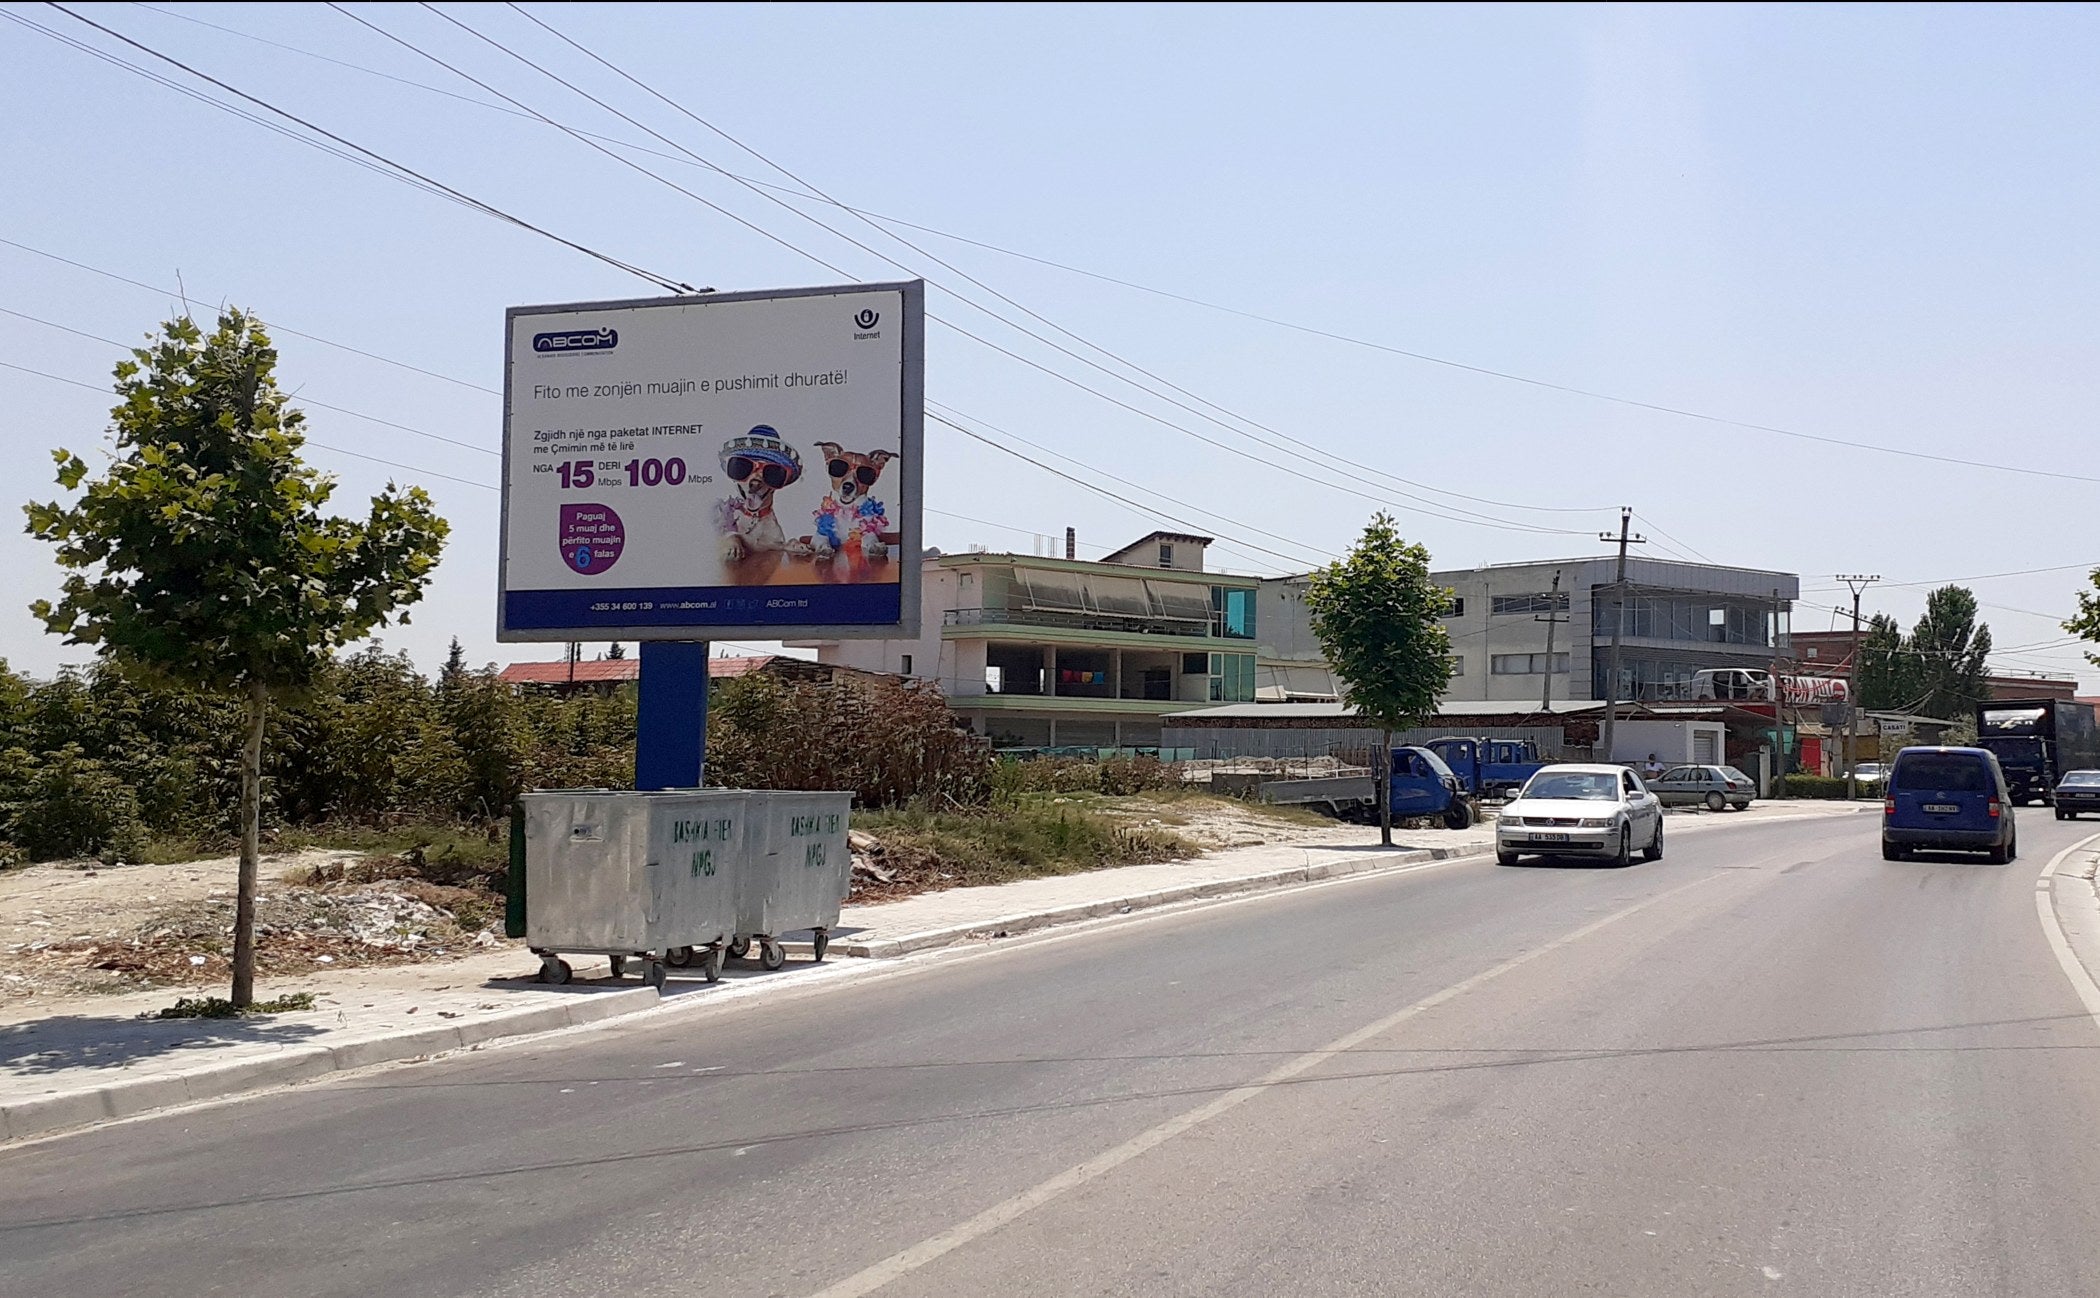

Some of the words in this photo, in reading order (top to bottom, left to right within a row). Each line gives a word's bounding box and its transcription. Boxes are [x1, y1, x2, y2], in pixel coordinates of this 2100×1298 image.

[537, 330, 613, 349] ABCOM
[854, 331, 880, 340] Internet
[534, 385, 561, 399] Fito
[566, 386, 589, 397] me
[594, 381, 642, 399] zonjën
[648, 378, 696, 396] muajin
[701, 380, 710, 391] e
[715, 374, 779, 394] pushimit
[784, 370, 848, 388] dhuratë!
[534, 430, 566, 443] Zgjidh
[569, 430, 585, 441] një
[588, 431, 607, 441] nga
[610, 427, 649, 439] paketat
[652, 425, 703, 436] INTERNET
[534, 445, 549, 454] me
[551, 444, 587, 455] Çmimin
[590, 442, 605, 452] më
[608, 442, 617, 451] të
[620, 441, 635, 451] lirë
[533, 464, 554, 473] NGA
[598, 461, 621, 471] DERI
[556, 460, 594, 489] 15
[624, 457, 686, 487] 100
[598, 478, 622, 487] Mbps
[688, 474, 713, 484] Mbps
[576, 512, 606, 522] Paguaj
[576, 524, 597, 533] muaj
[599, 524, 616, 532] dhe
[562, 536, 590, 547] përfito
[592, 536, 621, 545] muajin
[576, 545, 592, 569] 6
[594, 550, 615, 558] falas
[590, 602, 609, 611] +355
[610, 602, 621, 610] 34
[622, 602, 637, 610] 600
[638, 602, 653, 610] 139
